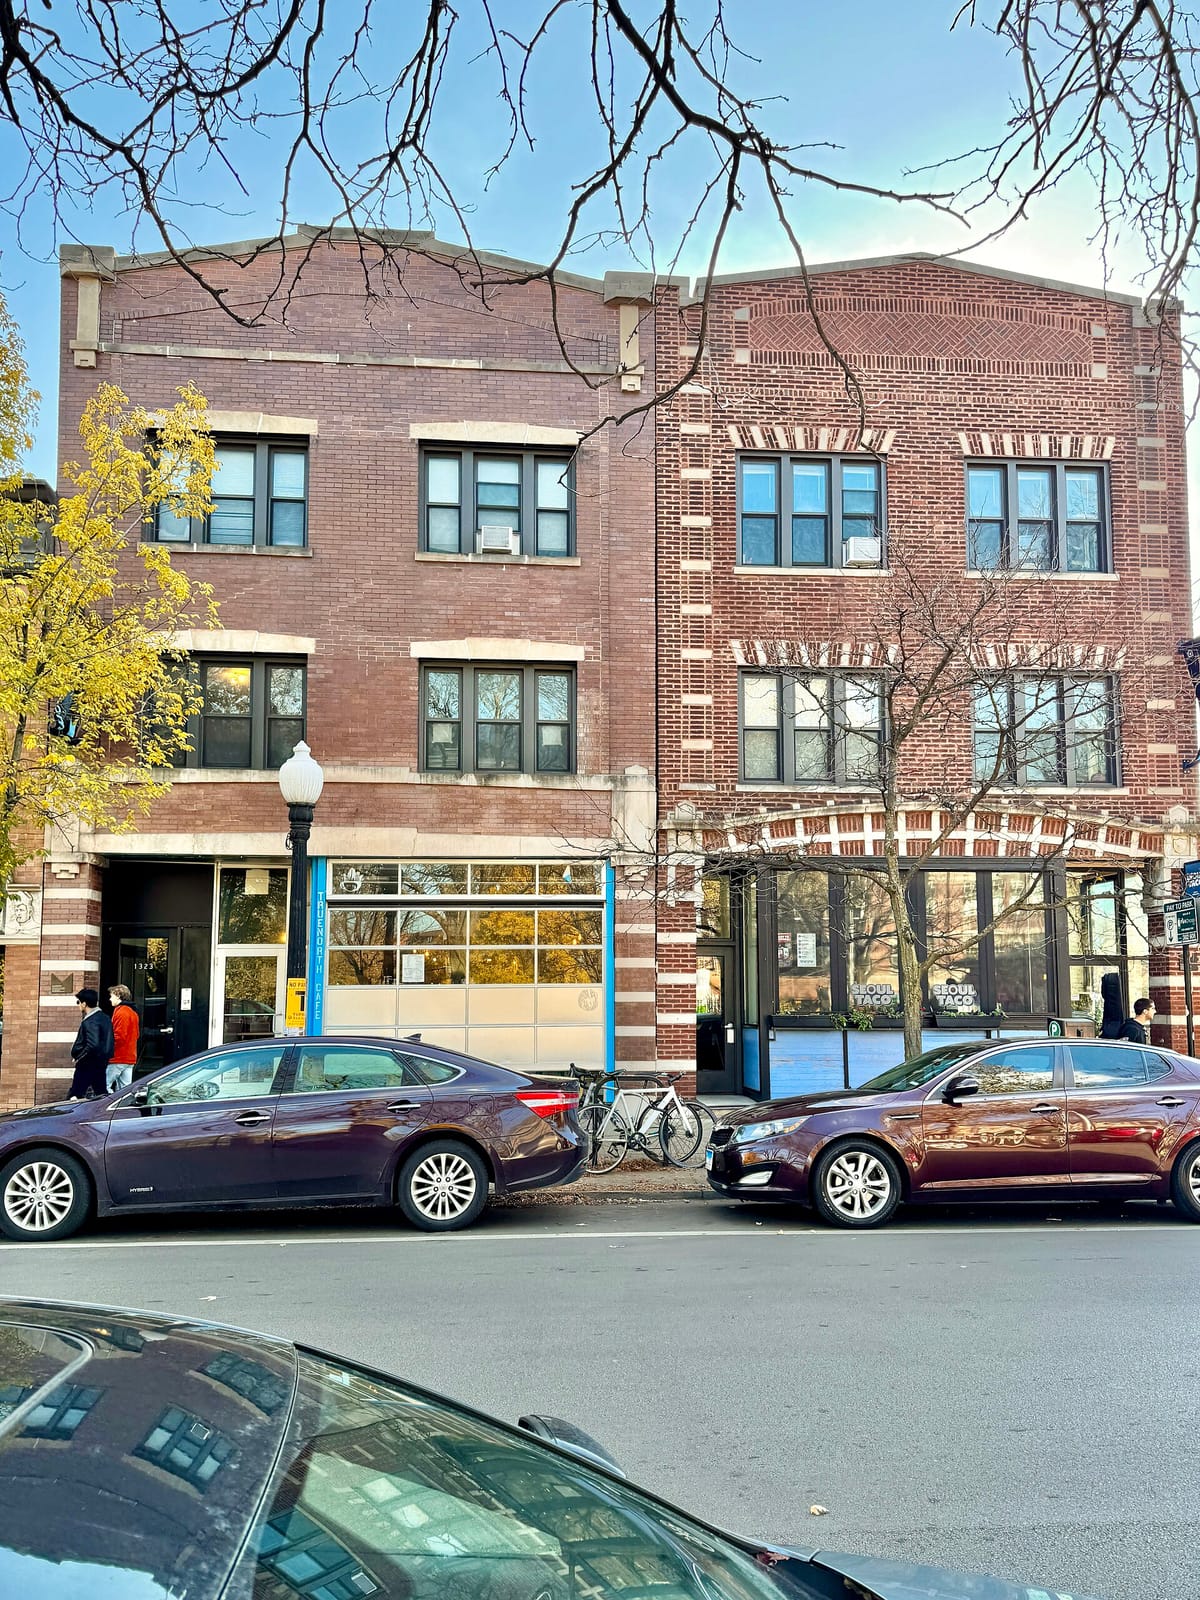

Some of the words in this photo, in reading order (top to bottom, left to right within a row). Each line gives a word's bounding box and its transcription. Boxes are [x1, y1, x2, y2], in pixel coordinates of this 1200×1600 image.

[1166, 904, 1175, 912] PAY
[1175, 902, 1182, 910] TO
[1182, 900, 1194, 909] PARK
[316, 891, 324, 974] TRUENORTH
[851, 983, 894, 995] SEOUL
[932, 983, 976, 996] SEOUL
[854, 994, 892, 1006] TACO
[936, 995, 974, 1006] TACO
